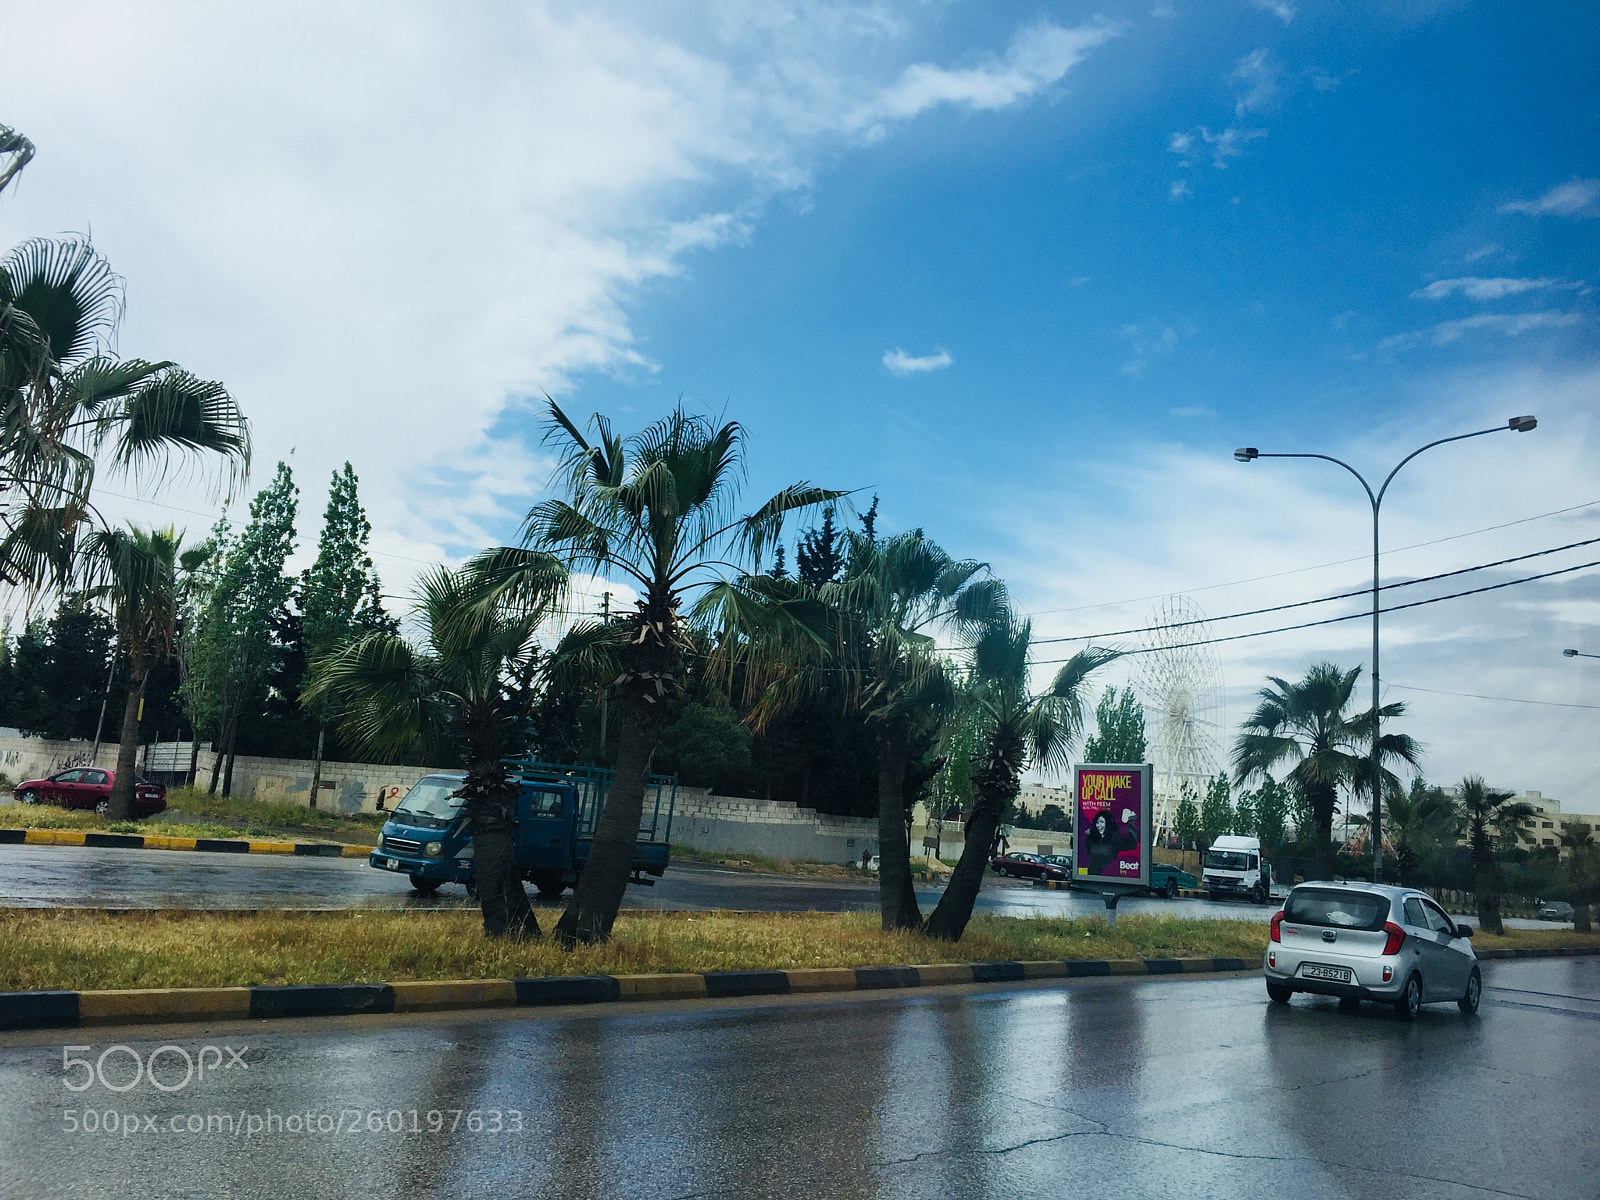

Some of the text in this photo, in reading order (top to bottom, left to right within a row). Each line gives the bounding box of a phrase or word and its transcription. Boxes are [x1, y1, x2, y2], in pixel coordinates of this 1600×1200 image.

[1083, 775, 1131, 788] YOUR WAKE
[1082, 786, 1116, 800] UP CALL
[1119, 860, 1139, 870] Beat
